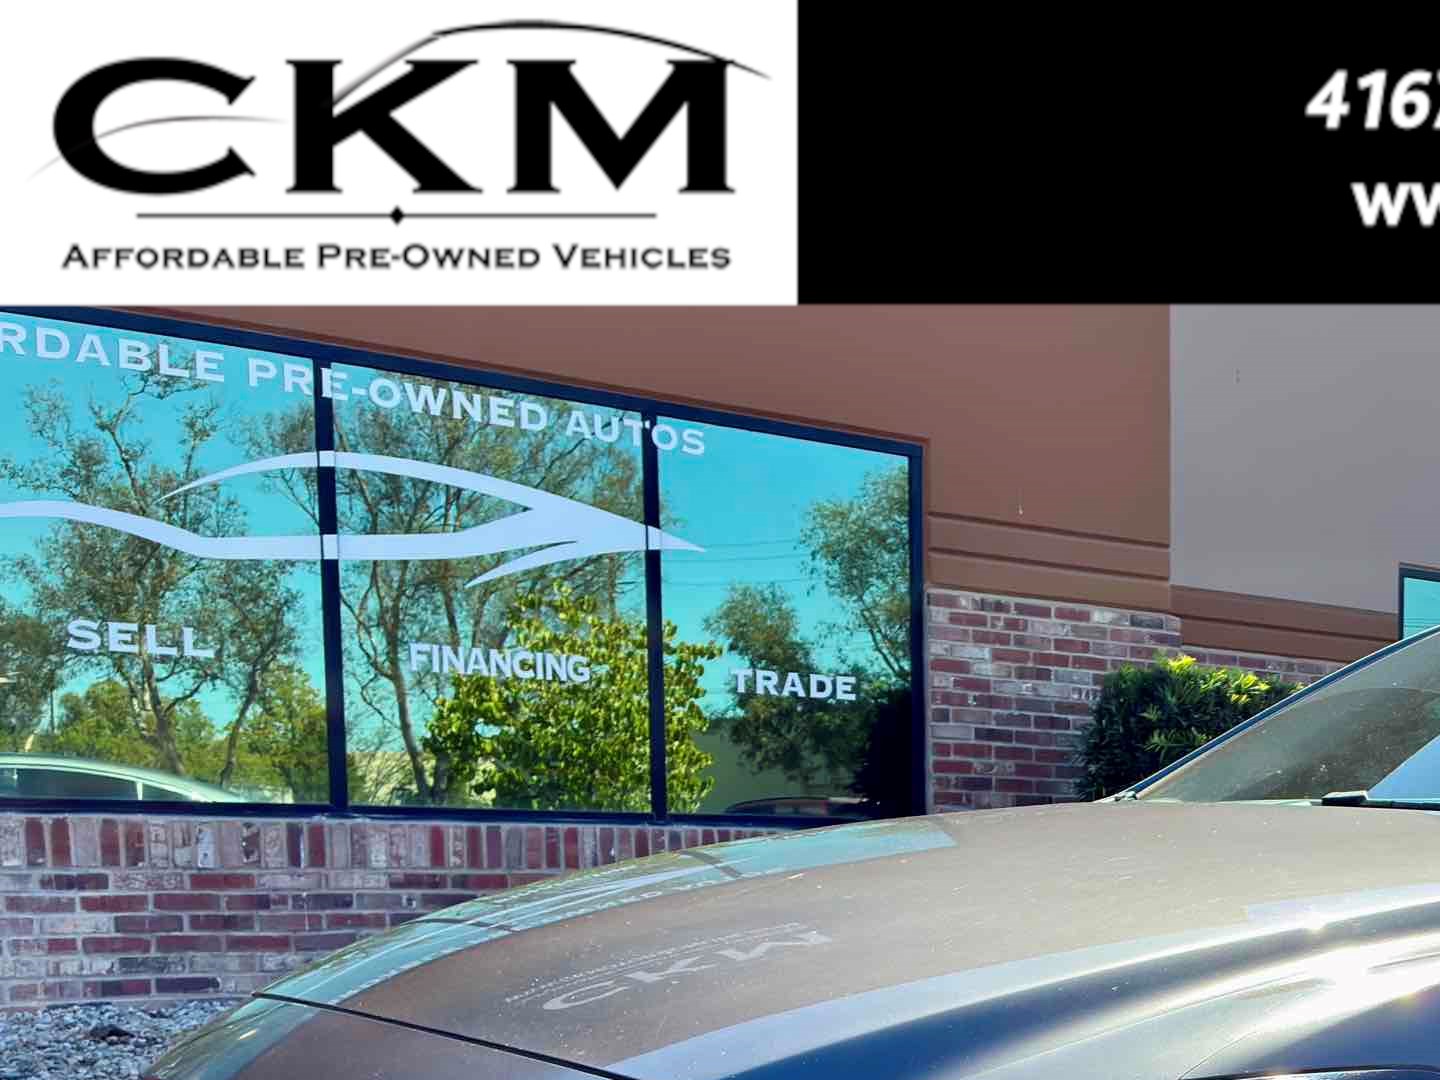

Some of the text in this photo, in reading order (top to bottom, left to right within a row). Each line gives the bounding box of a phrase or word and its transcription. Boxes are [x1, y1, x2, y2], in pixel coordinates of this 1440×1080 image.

[247, 357, 549, 433] PRE-OWNED
[565, 410, 705, 456] AUTOS
[67, 619, 215, 658] SELL
[408, 643, 592, 683] FINANCING
[731, 667, 858, 700] TRADE
